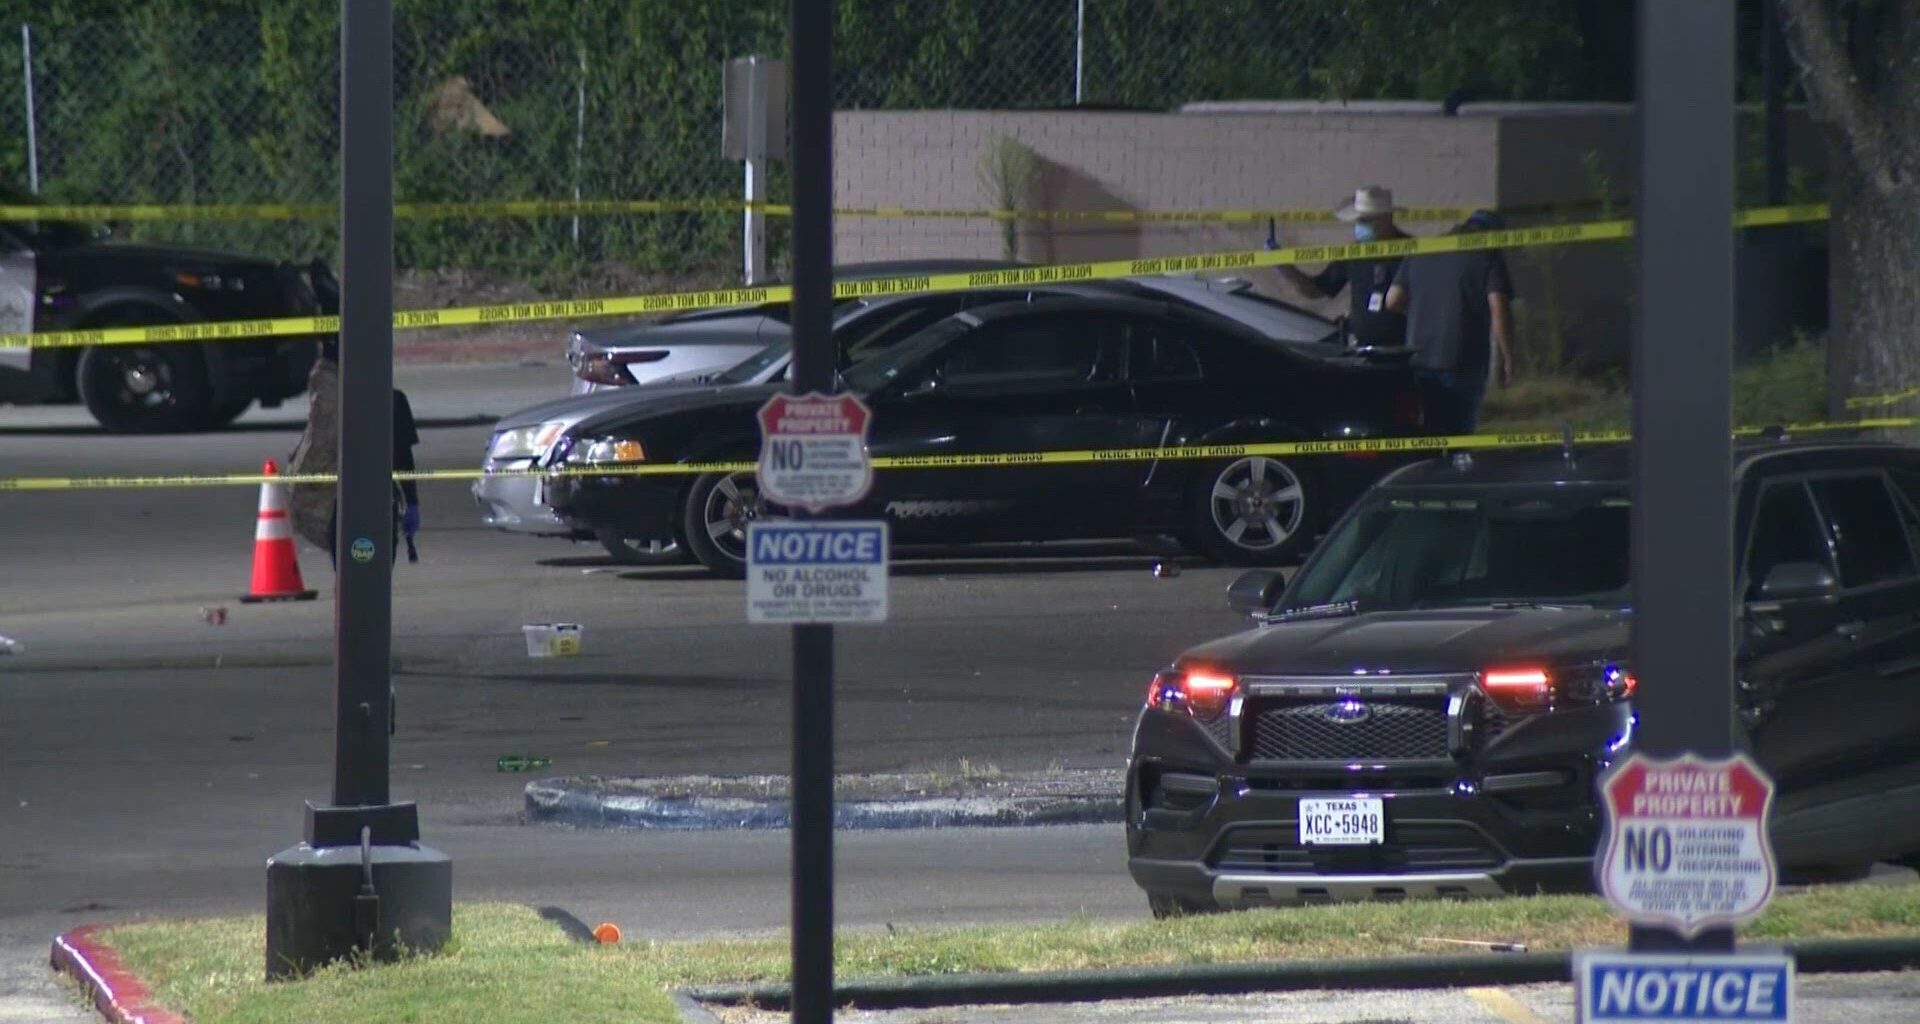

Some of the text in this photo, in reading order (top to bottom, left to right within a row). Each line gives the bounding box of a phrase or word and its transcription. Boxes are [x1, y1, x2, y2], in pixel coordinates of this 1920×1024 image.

[784, 403, 842, 417] PRIVATE
[777, 418, 849, 432] PROPERTY
[772, 441, 803, 471] NO
[758, 532, 877, 561] NOTICE
[763, 568, 871, 583] NO ALCOHOL
[773, 583, 862, 598] OR DRUGS
[1645, 772, 1731, 793] PRIVATE
[1326, 802, 1357, 811] TEXAS
[1633, 795, 1742, 816] PROPERTY
[1624, 827, 1745, 873] NO SOLICITING
[1676, 860, 1762, 873] TRESPASSING
[1599, 970, 1778, 1013] NOTICE
